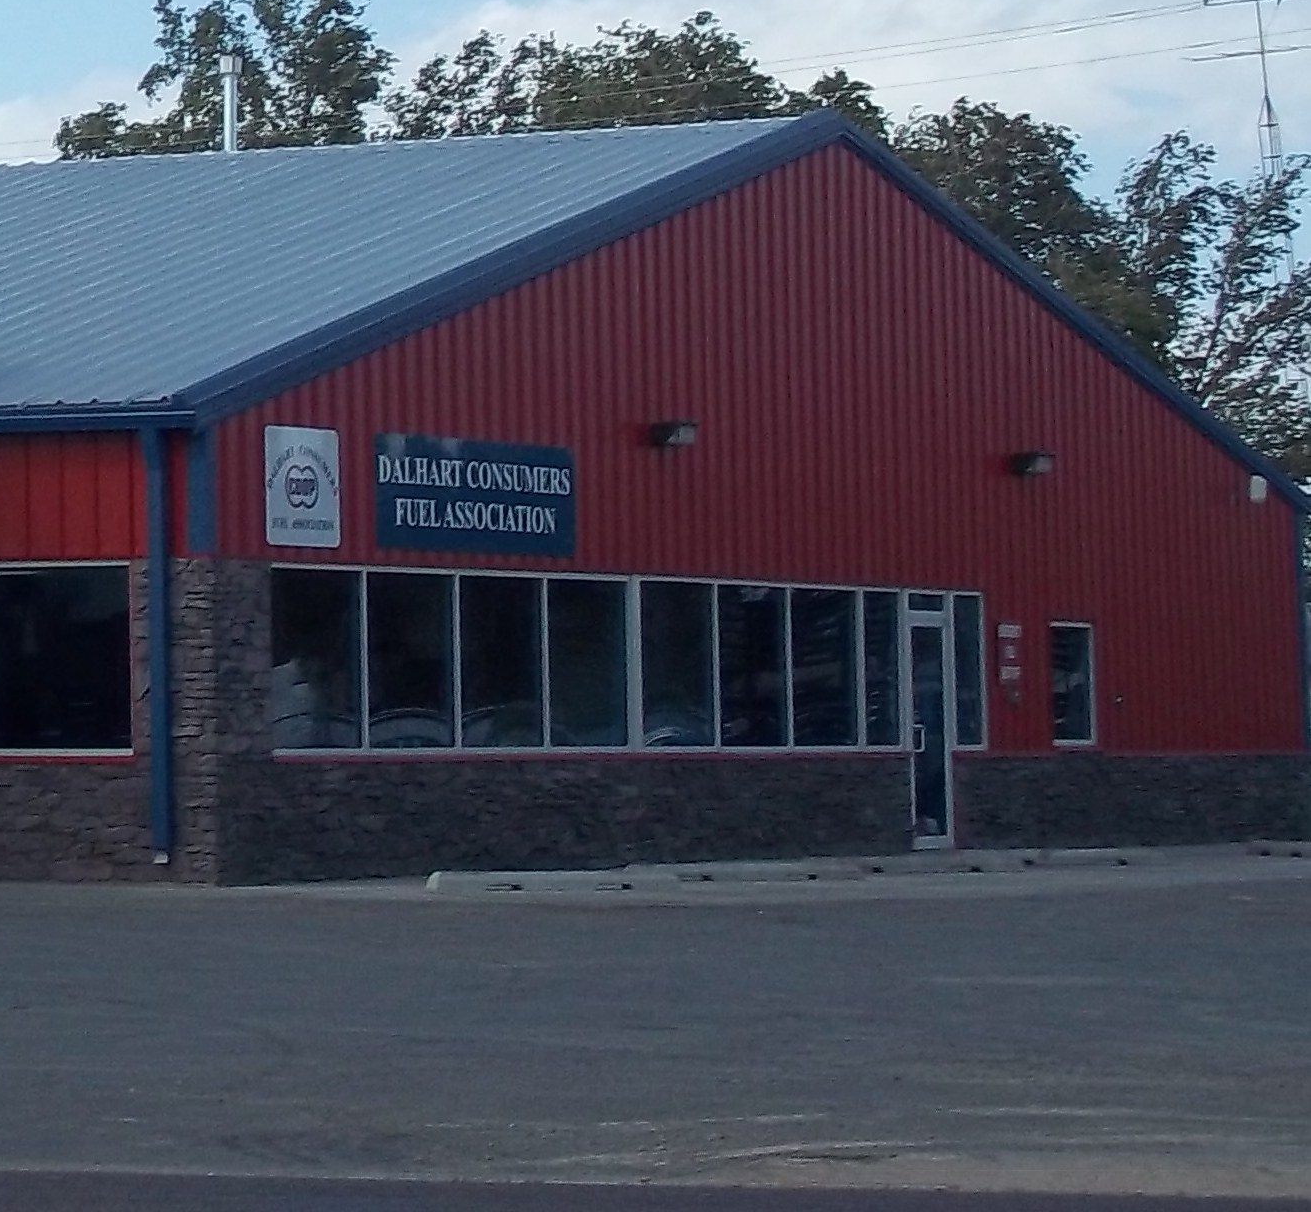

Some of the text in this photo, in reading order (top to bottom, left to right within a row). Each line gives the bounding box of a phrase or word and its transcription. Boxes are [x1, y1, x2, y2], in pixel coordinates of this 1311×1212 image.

[377, 454, 463, 487] DALHART
[466, 461, 571, 496] CONSUMERS
[395, 497, 557, 534] FUEL ASSOCIATION
